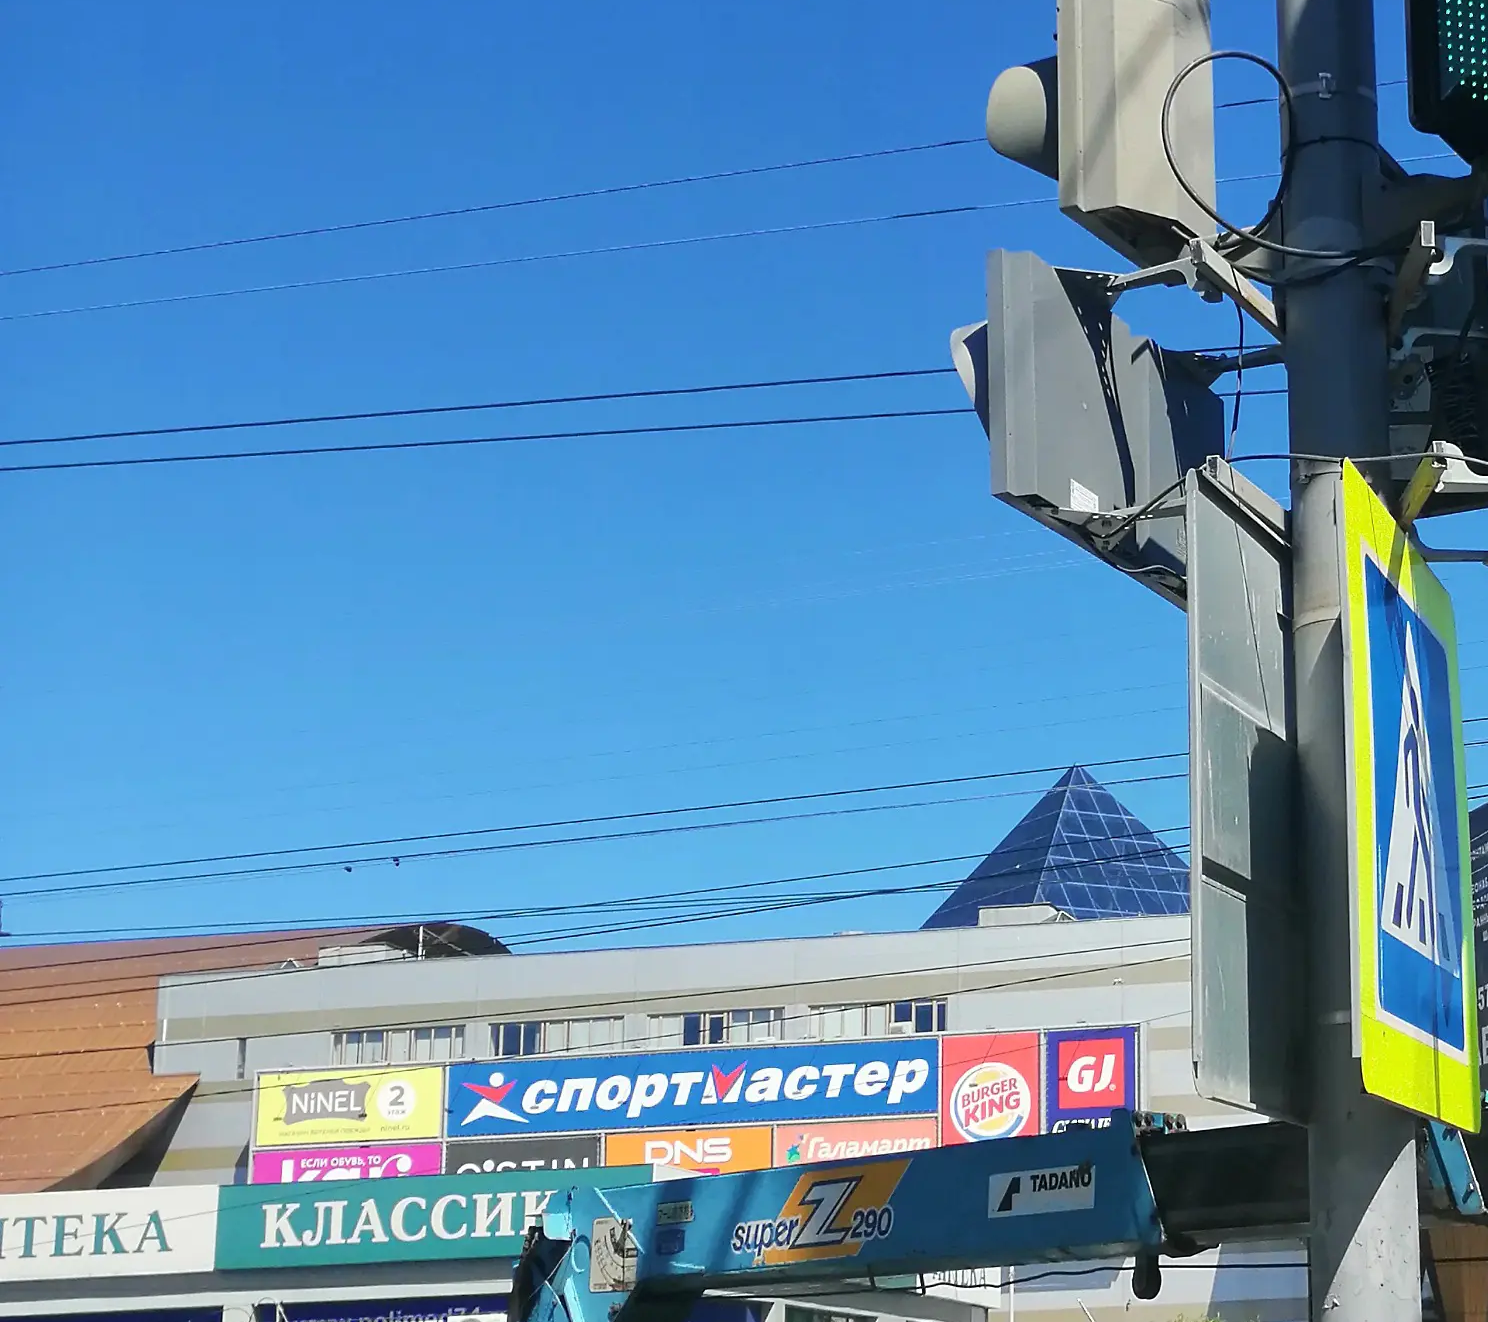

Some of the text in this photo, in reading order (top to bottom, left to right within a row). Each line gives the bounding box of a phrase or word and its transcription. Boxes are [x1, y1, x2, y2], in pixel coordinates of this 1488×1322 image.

[1067, 1054, 1116, 1093] GJ
[388, 1085, 405, 1107] 2
[962, 1078, 1018, 1109] BURGER
[964, 1091, 1021, 1128] KING
[301, 1157, 328, 1169] ЕСЛИ
[367, 1155, 382, 1165] ТО
[644, 1137, 733, 1166] DNS
[1030, 1169, 1092, 1193] TADANO
[0, 1209, 173, 1260] ТЕКА
[852, 1207, 891, 1239] 290
